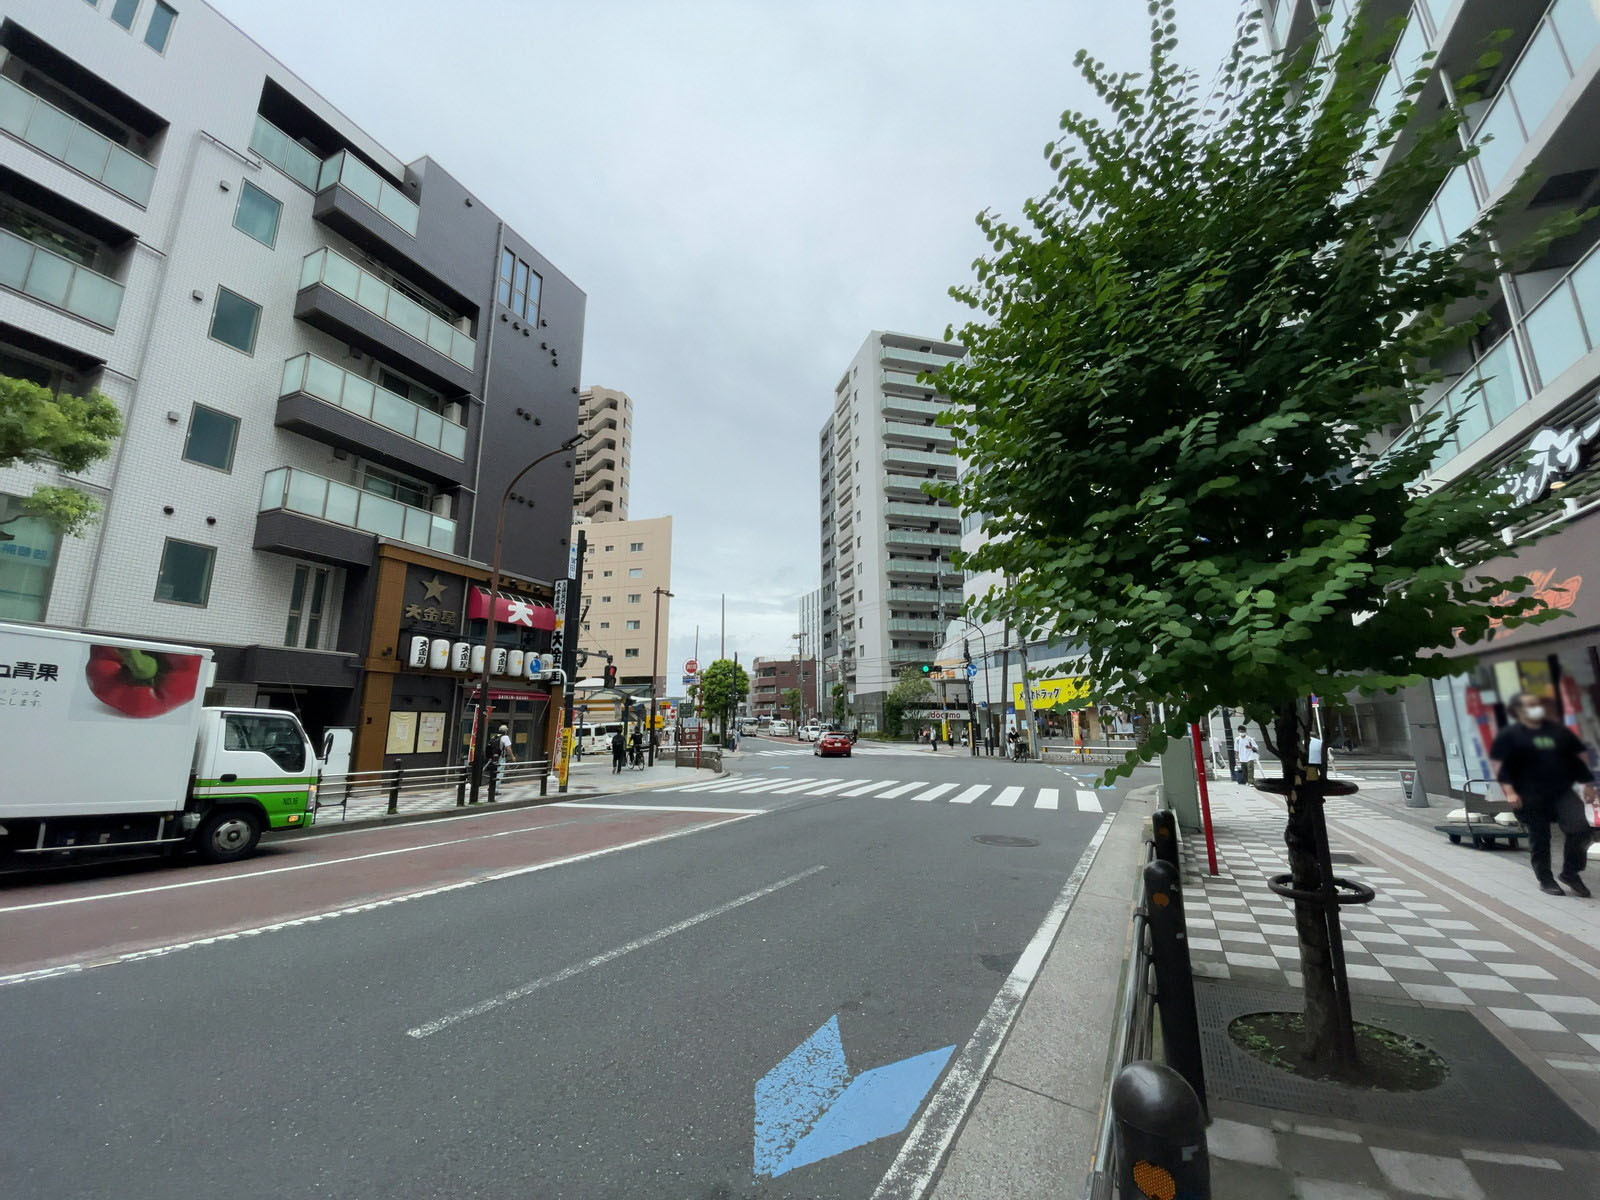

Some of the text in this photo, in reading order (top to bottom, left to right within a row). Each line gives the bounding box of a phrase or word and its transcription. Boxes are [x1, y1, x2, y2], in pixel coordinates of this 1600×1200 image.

[405, 604, 457, 625] 大金星
[508, 600, 533, 627] 大
[930, 711, 961, 719] docmo
